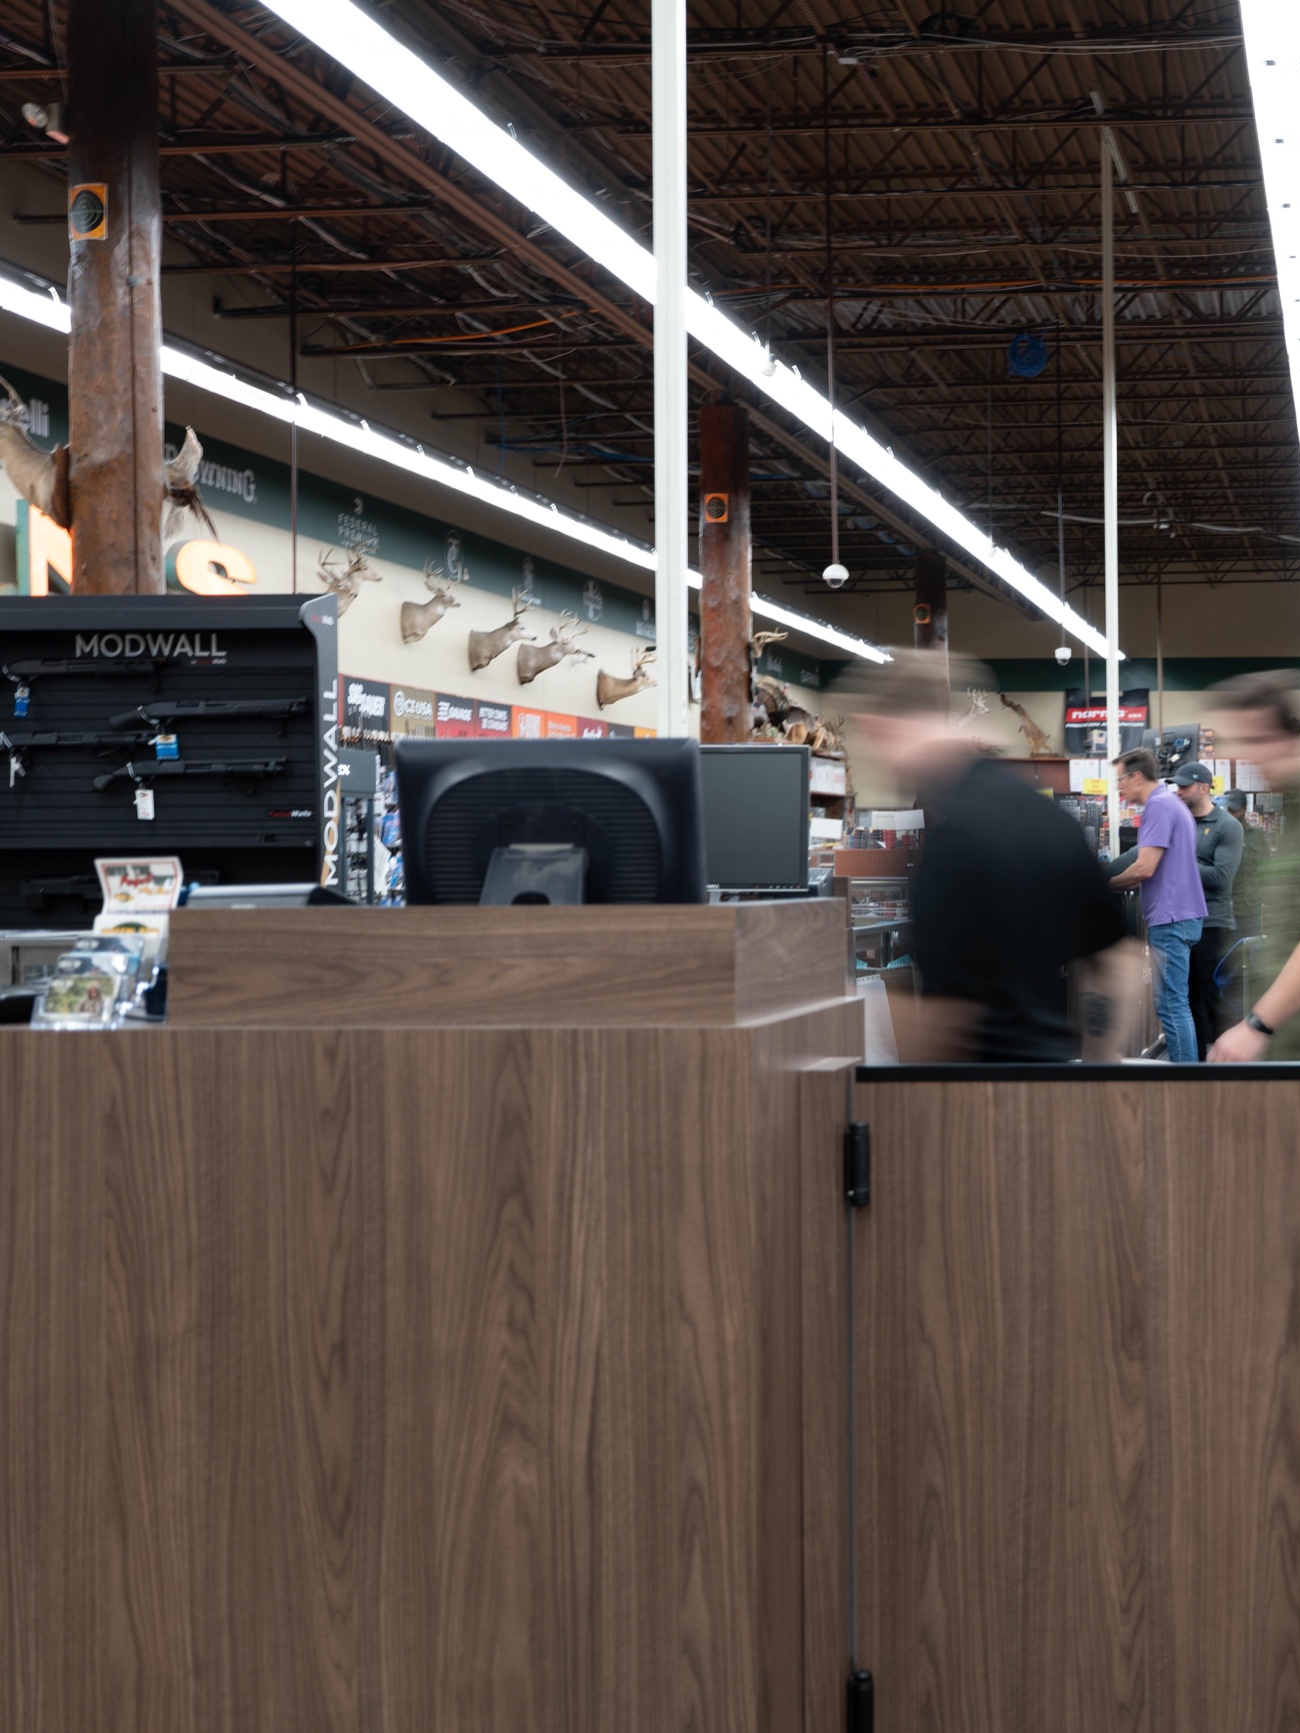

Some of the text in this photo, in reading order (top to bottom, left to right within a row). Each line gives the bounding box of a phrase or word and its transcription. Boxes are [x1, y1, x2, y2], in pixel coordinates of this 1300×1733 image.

[338, 513, 378, 537] FEDERAL
[75, 633, 227, 658] MODWALL
[404, 698, 433, 717] CZ-USA
[449, 706, 473, 722] SAVAGE
[323, 678, 339, 886] MODWALL
